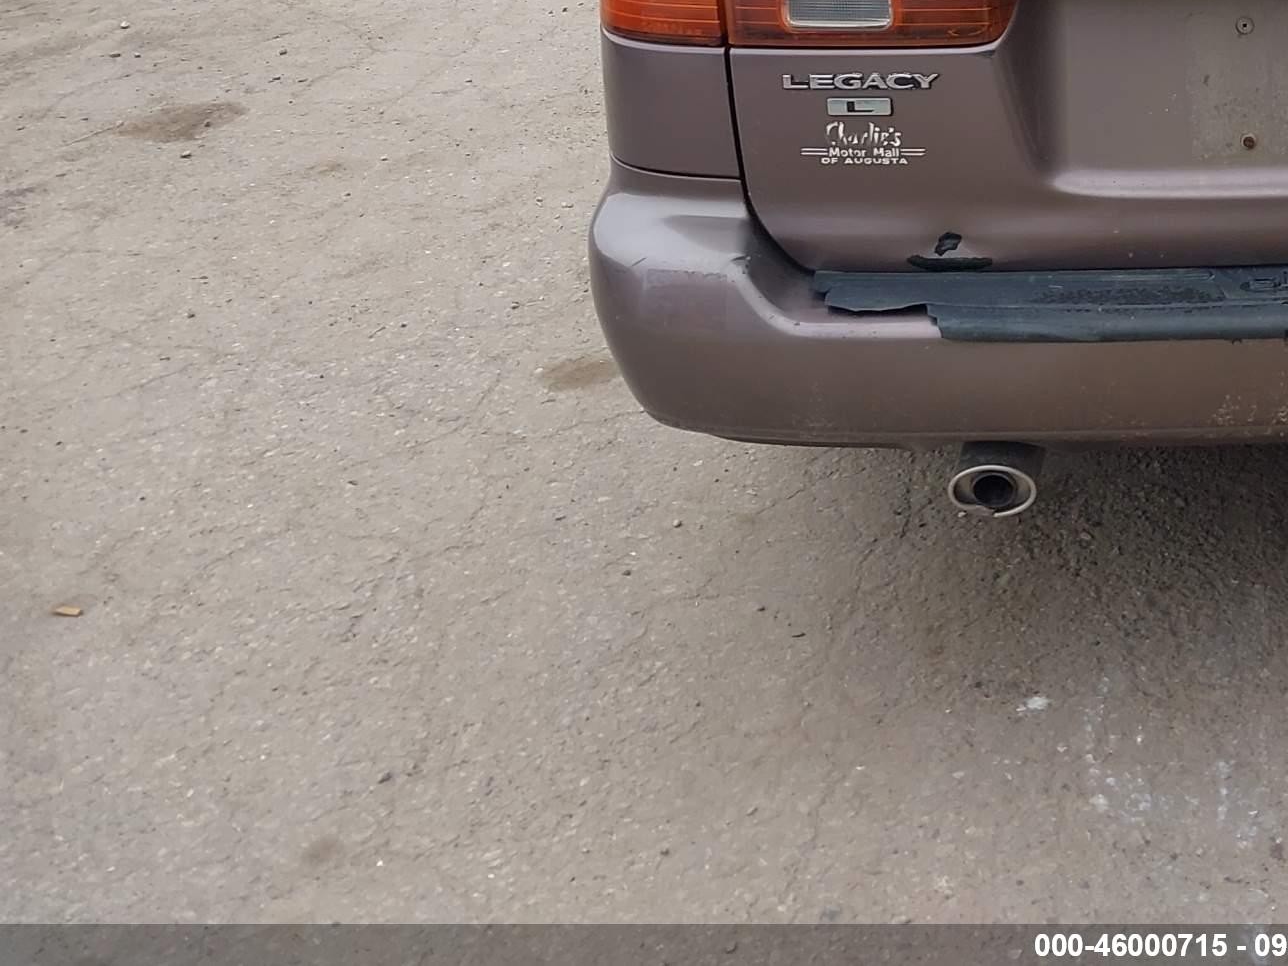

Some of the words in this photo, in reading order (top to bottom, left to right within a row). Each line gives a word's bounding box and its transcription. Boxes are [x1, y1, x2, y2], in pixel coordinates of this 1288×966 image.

[782, 72, 939, 90] LEGACY
[846, 101, 874, 113] L
[828, 147, 866, 157] Motor
[873, 147, 900, 157] Mall
[821, 157, 838, 165] OF
[844, 157, 908, 165] AUGUSTA
